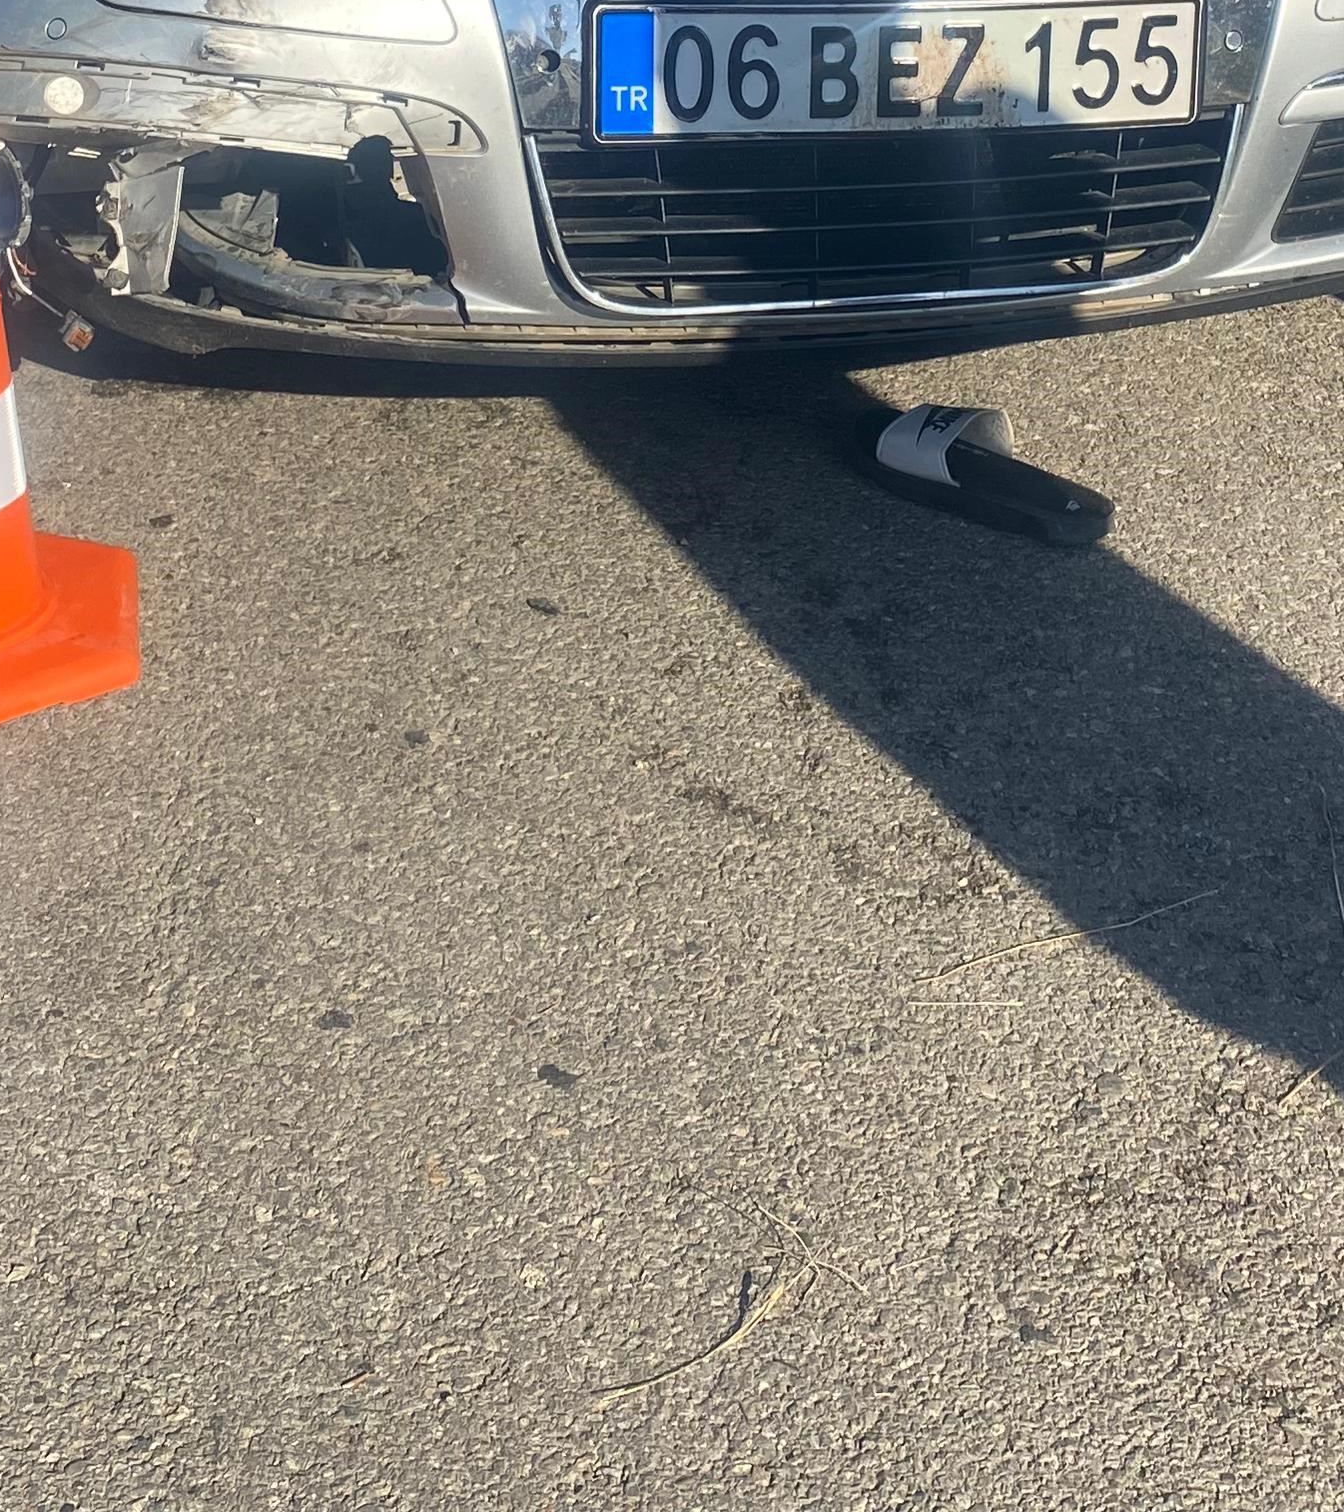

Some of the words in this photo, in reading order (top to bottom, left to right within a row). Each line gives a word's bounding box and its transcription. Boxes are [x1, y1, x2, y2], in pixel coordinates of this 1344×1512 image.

[610, 85, 649, 113] TR
[662, 23, 780, 123] 06
[808, 22, 987, 120] BEZ
[1024, 13, 1179, 114] 155
